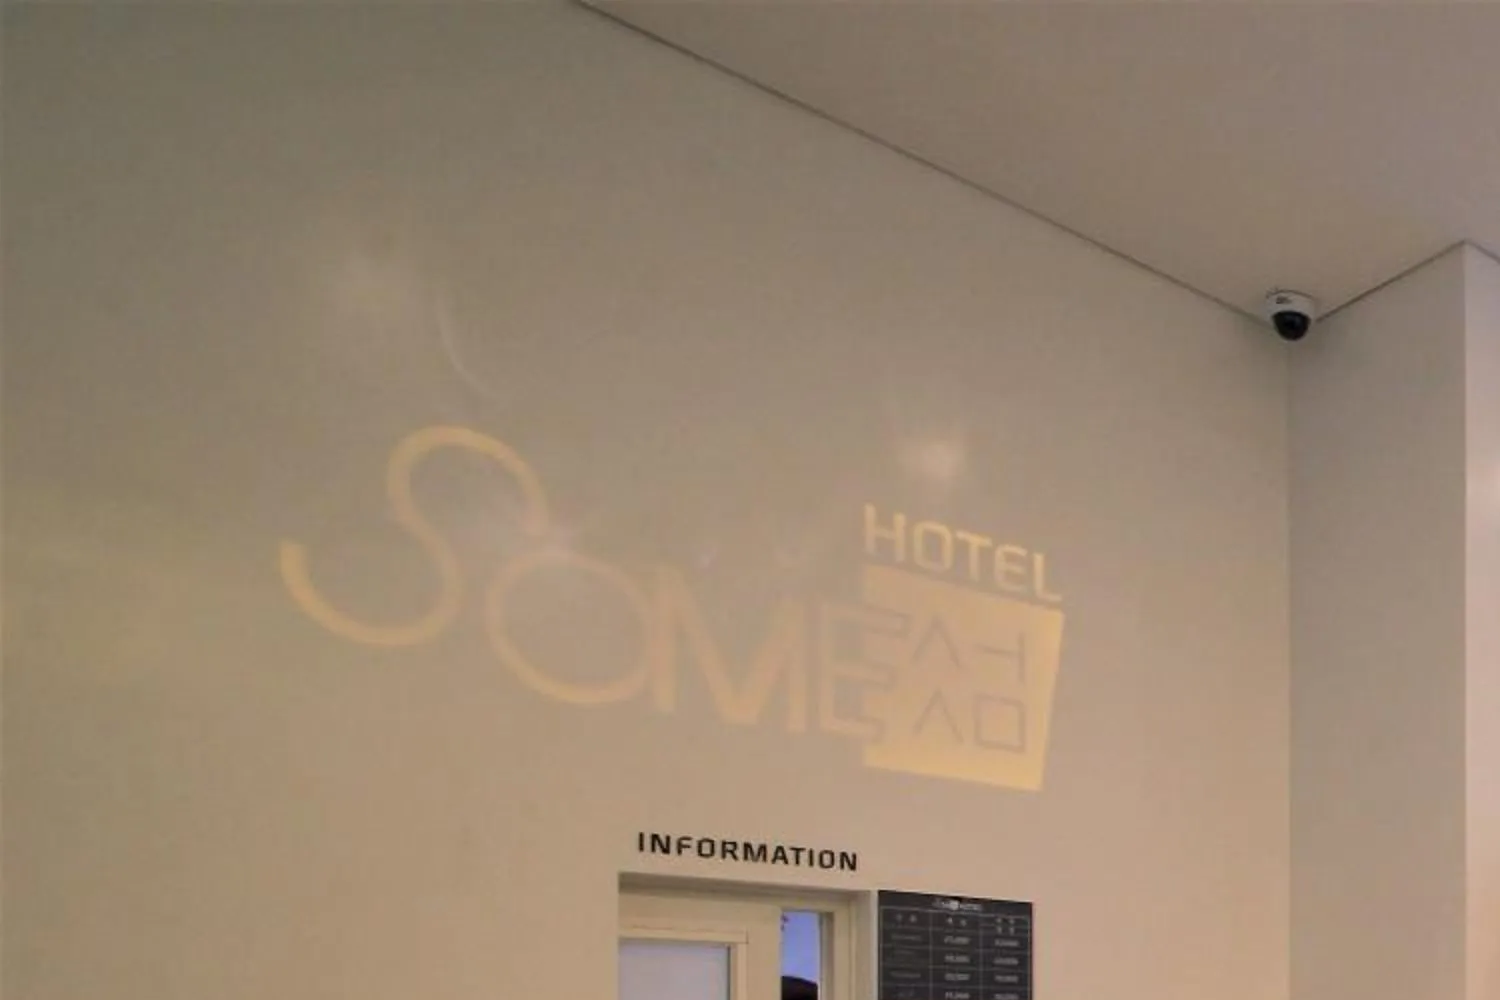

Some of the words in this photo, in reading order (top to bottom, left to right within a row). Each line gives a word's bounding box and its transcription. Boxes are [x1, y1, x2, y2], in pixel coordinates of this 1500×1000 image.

[280, 424, 909, 742] SOME
[863, 502, 1063, 602] HOTEL
[637, 832, 857, 871] INFORMATION
